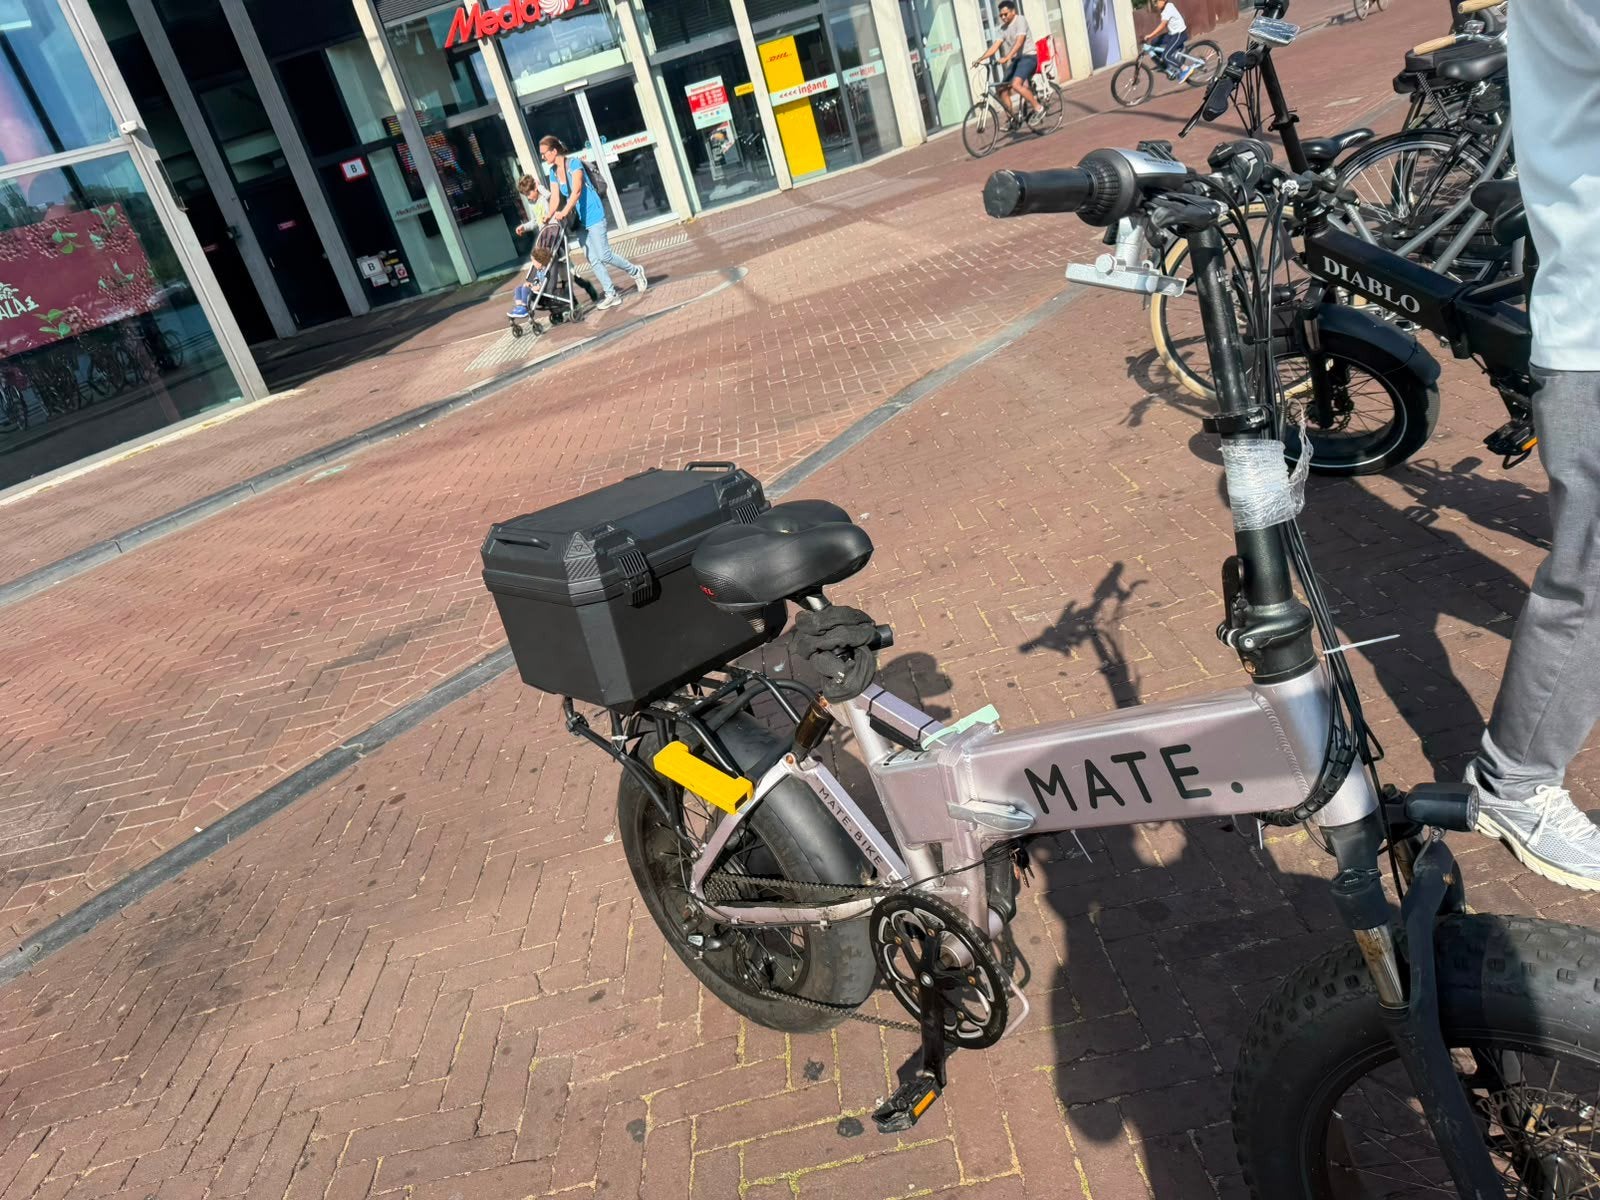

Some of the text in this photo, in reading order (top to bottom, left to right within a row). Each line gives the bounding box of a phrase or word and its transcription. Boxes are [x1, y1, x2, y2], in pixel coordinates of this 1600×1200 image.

[350, 164, 358, 173] B
[367, 262, 376, 272] B
[1322, 255, 1421, 314] DIABLO
[1023, 743, 1245, 815] MATE.
[818, 787, 884, 866] MATE.BIKE
